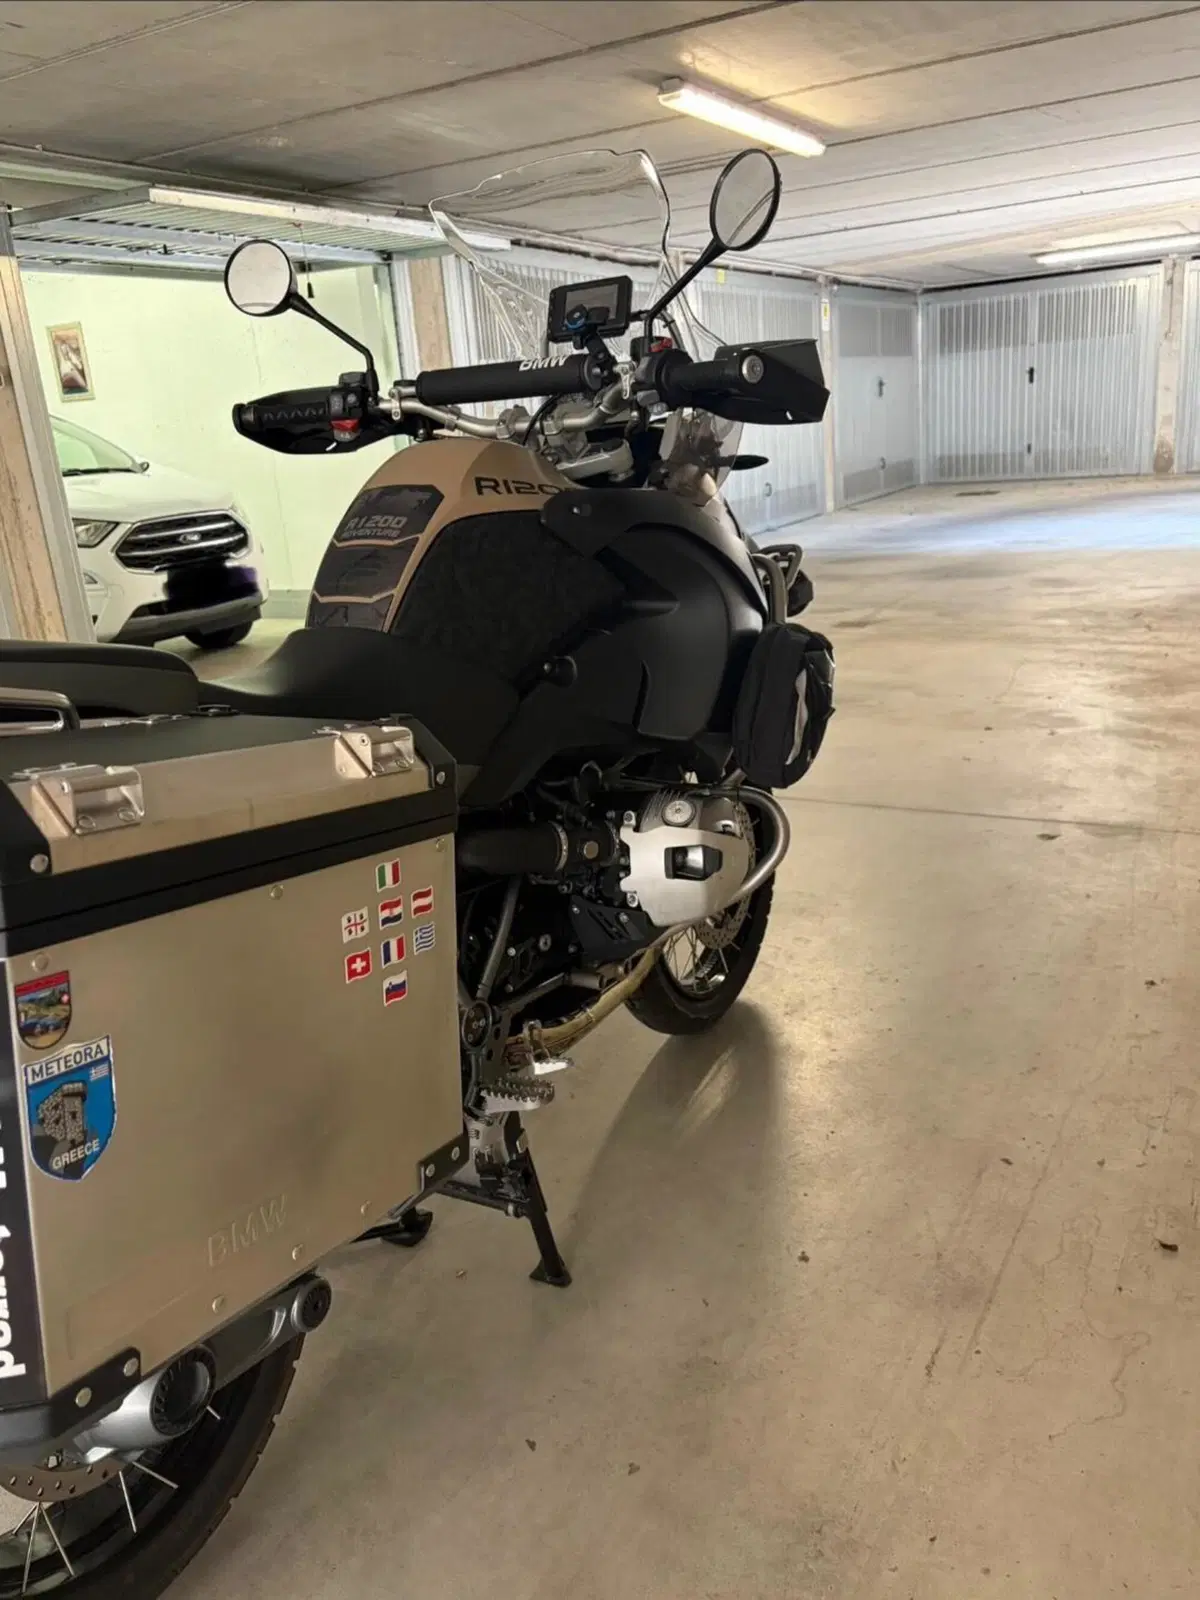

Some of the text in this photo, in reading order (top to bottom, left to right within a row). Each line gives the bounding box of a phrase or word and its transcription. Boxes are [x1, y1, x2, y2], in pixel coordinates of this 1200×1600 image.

[474, 476, 573, 496] R120
[31, 1044, 104, 1081] METEORA
[52, 1139, 100, 1170] GREECE
[206, 1193, 287, 1267] BMW
